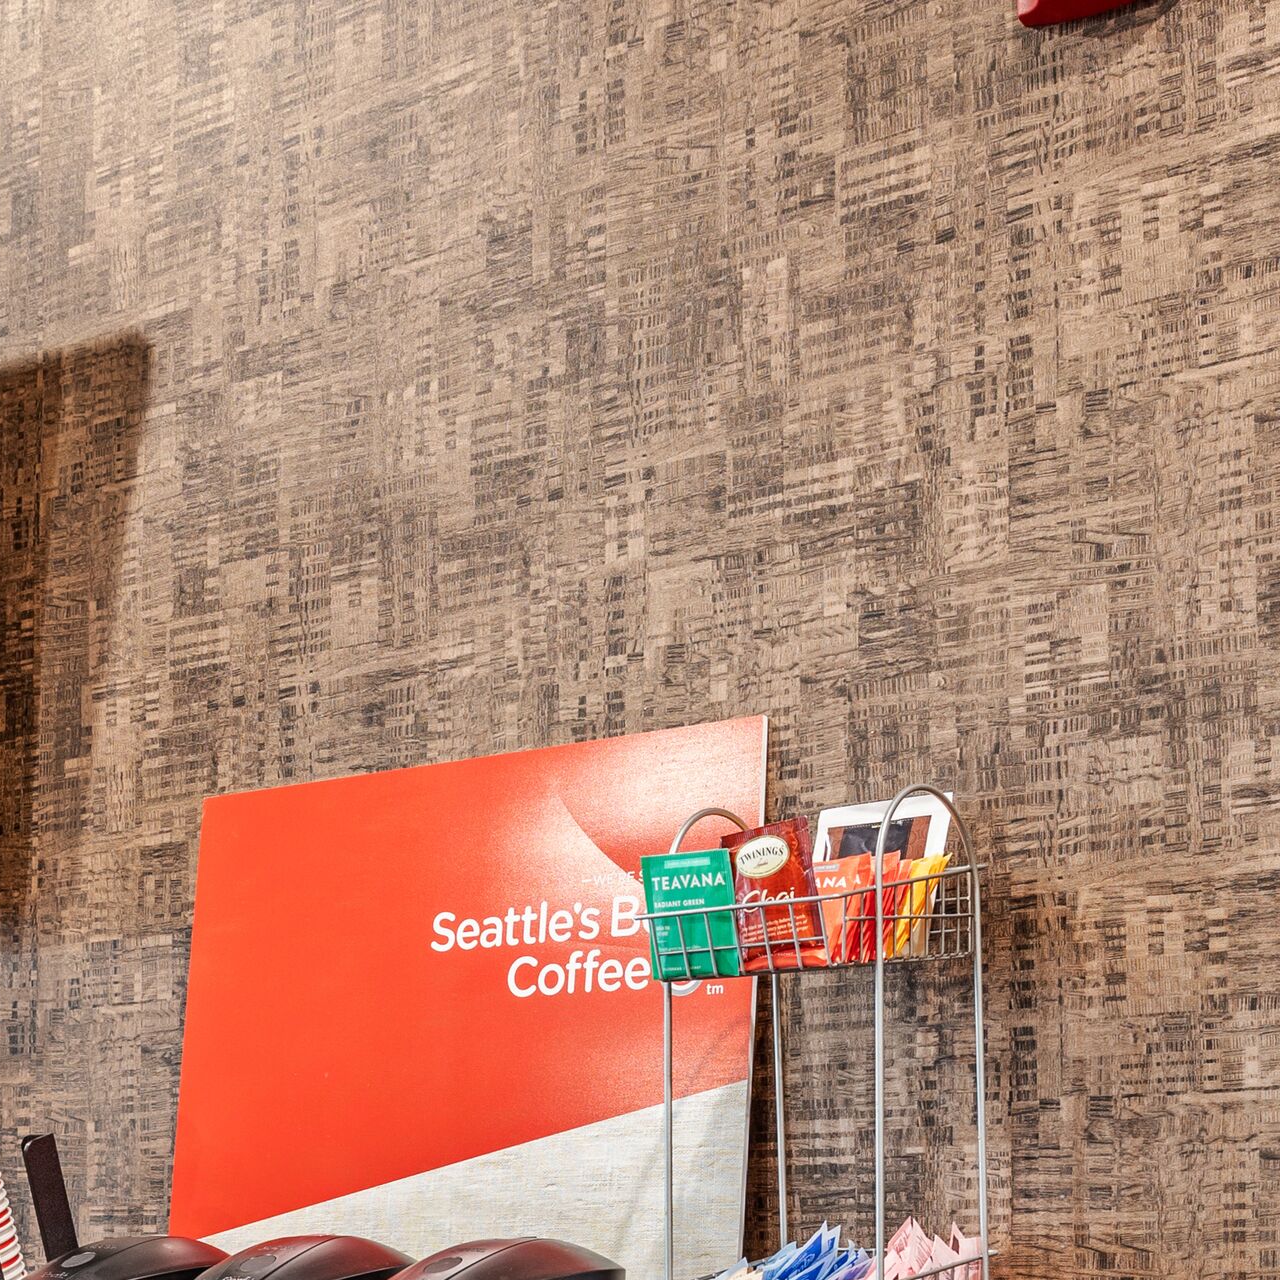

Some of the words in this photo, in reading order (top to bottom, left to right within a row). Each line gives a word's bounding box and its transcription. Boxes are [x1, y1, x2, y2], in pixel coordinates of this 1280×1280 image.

[739, 846, 785, 865] TWININGS
[651, 872, 725, 891] TEAVANA
[683, 898, 705, 907] GREEN
[430, 900, 601, 952] Seattle's
[507, 949, 651, 998] Coffee
[706, 983, 724, 995] tm
